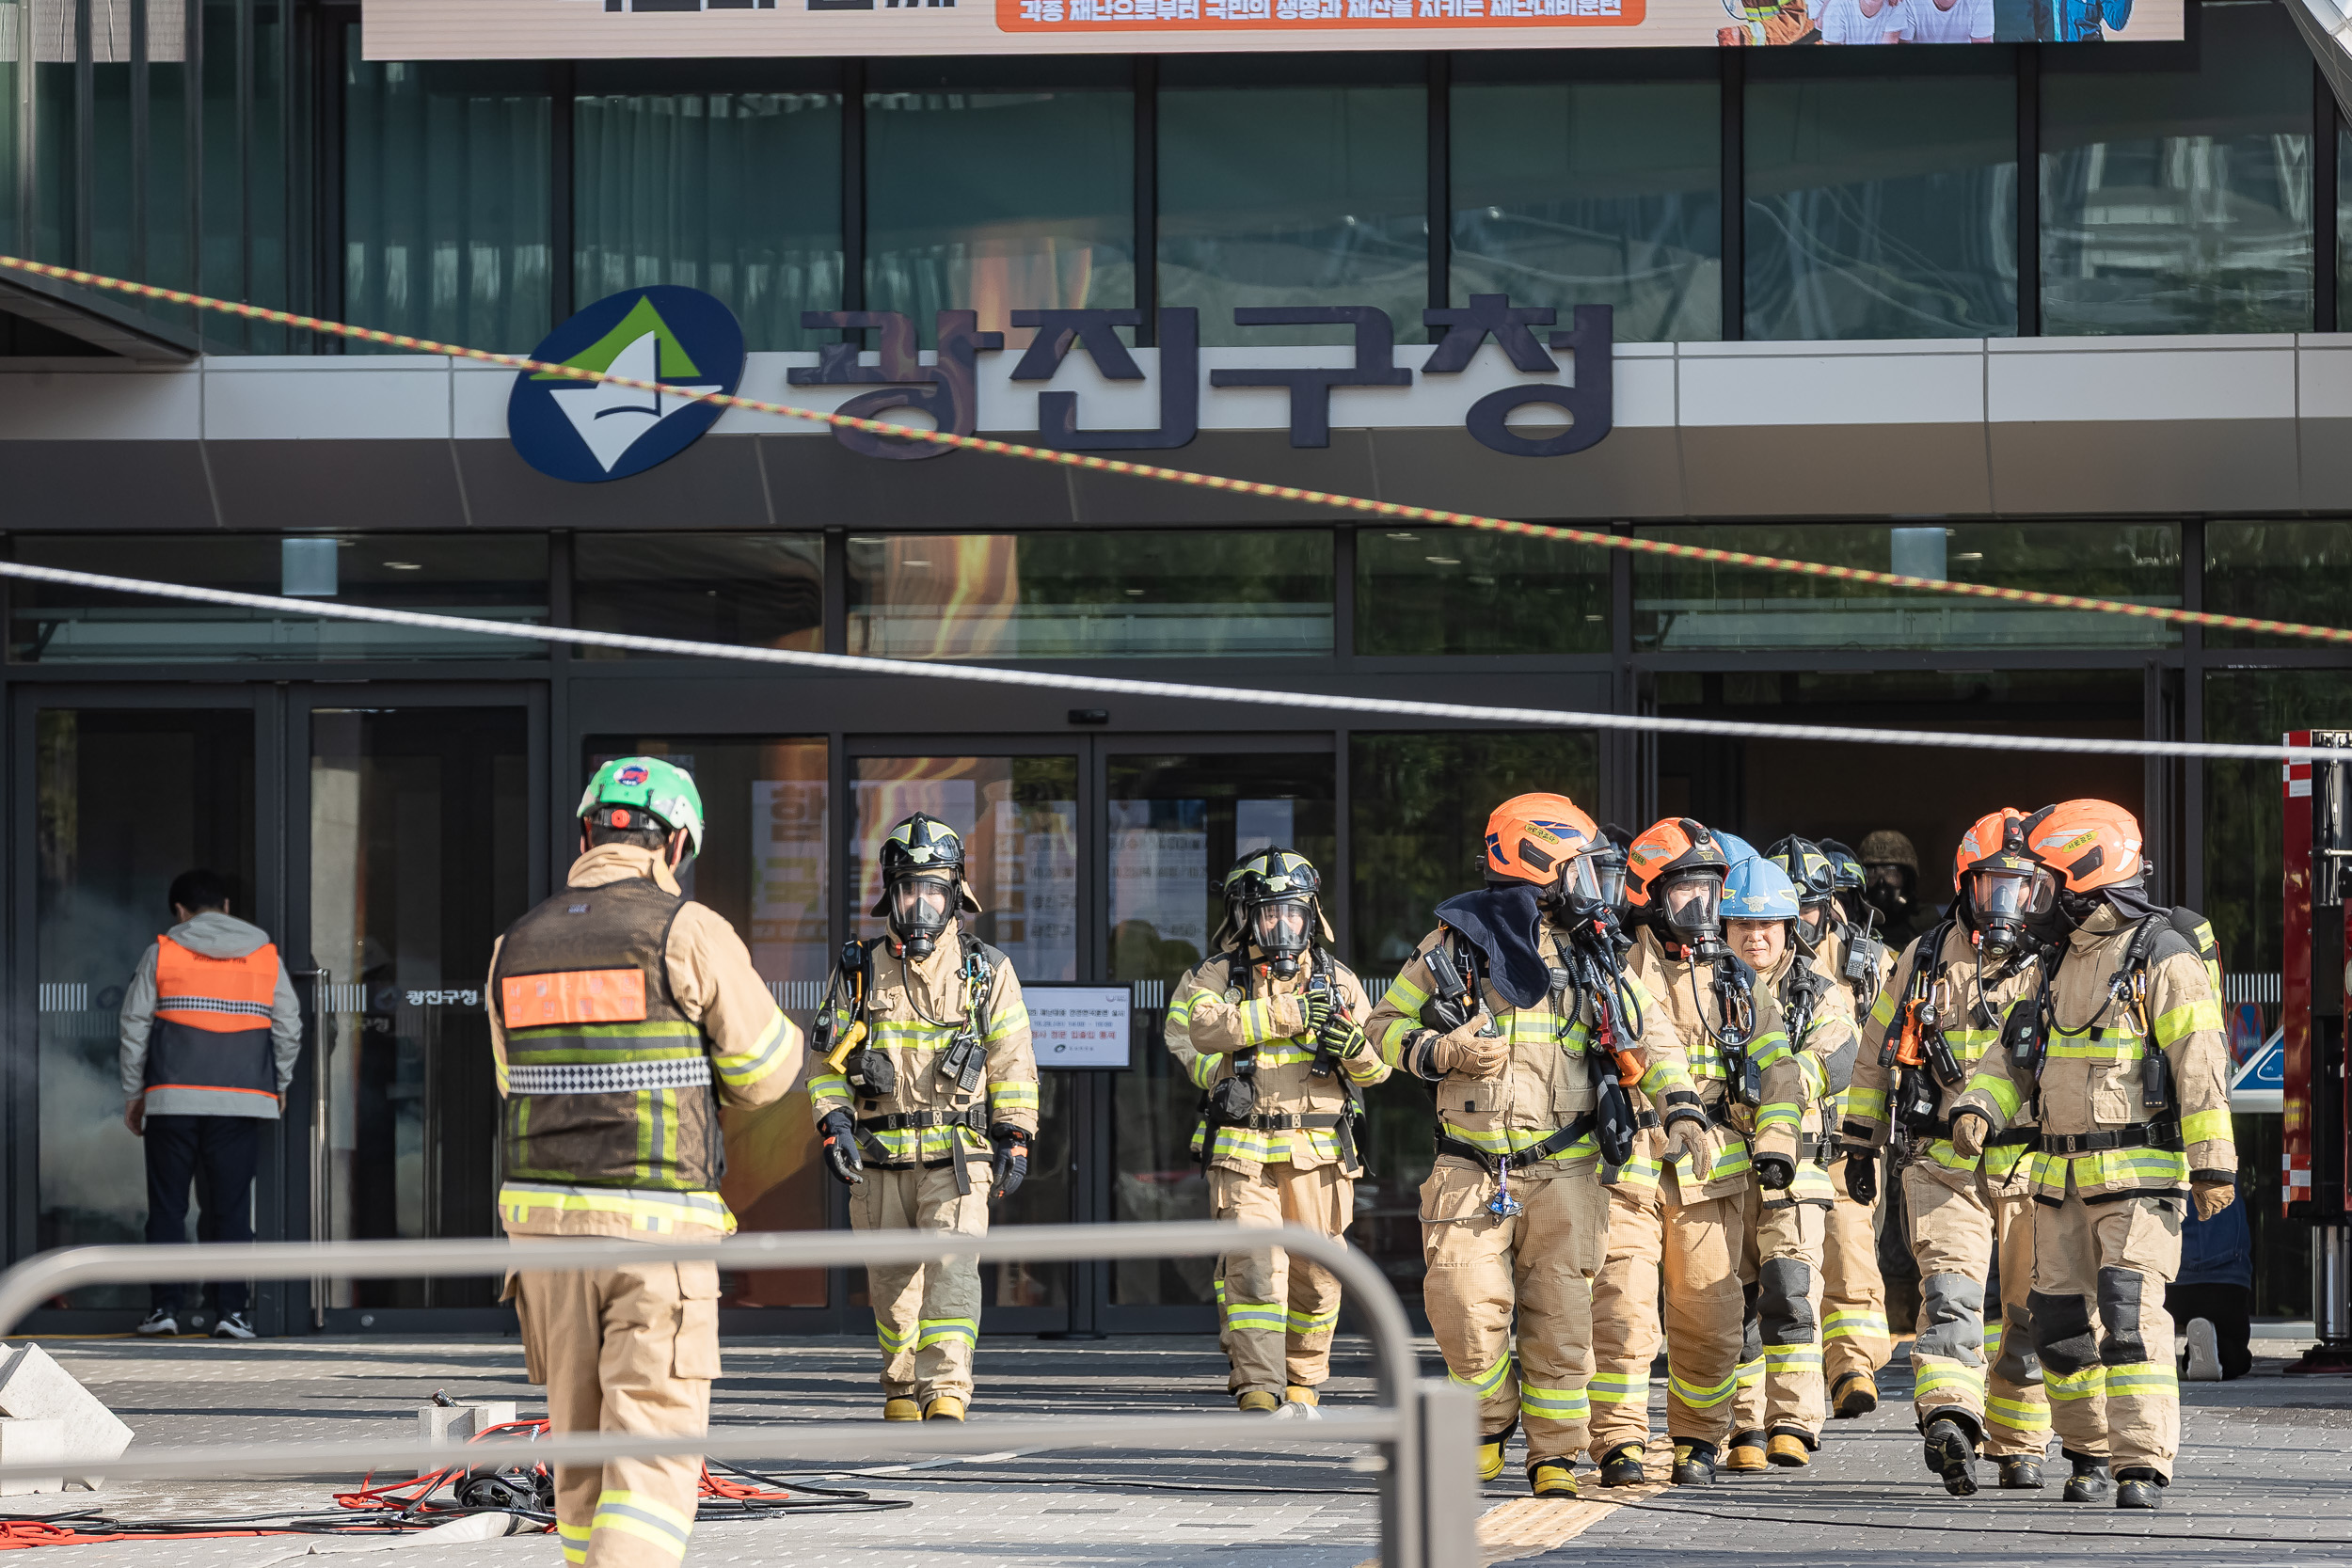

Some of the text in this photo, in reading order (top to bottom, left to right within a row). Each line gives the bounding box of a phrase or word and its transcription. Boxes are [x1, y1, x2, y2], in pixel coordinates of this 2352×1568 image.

[1019, 0, 1064, 22] 각종
[1069, 0, 1200, 21] 재난으로부터
[1205, 0, 1271, 20] 국민의
[1276, 0, 1343, 20] 생명과
[1347, 0, 1413, 19] 재산을
[787, 293, 1613, 460] 광진구청
[405, 990, 478, 1006] 광진구청
